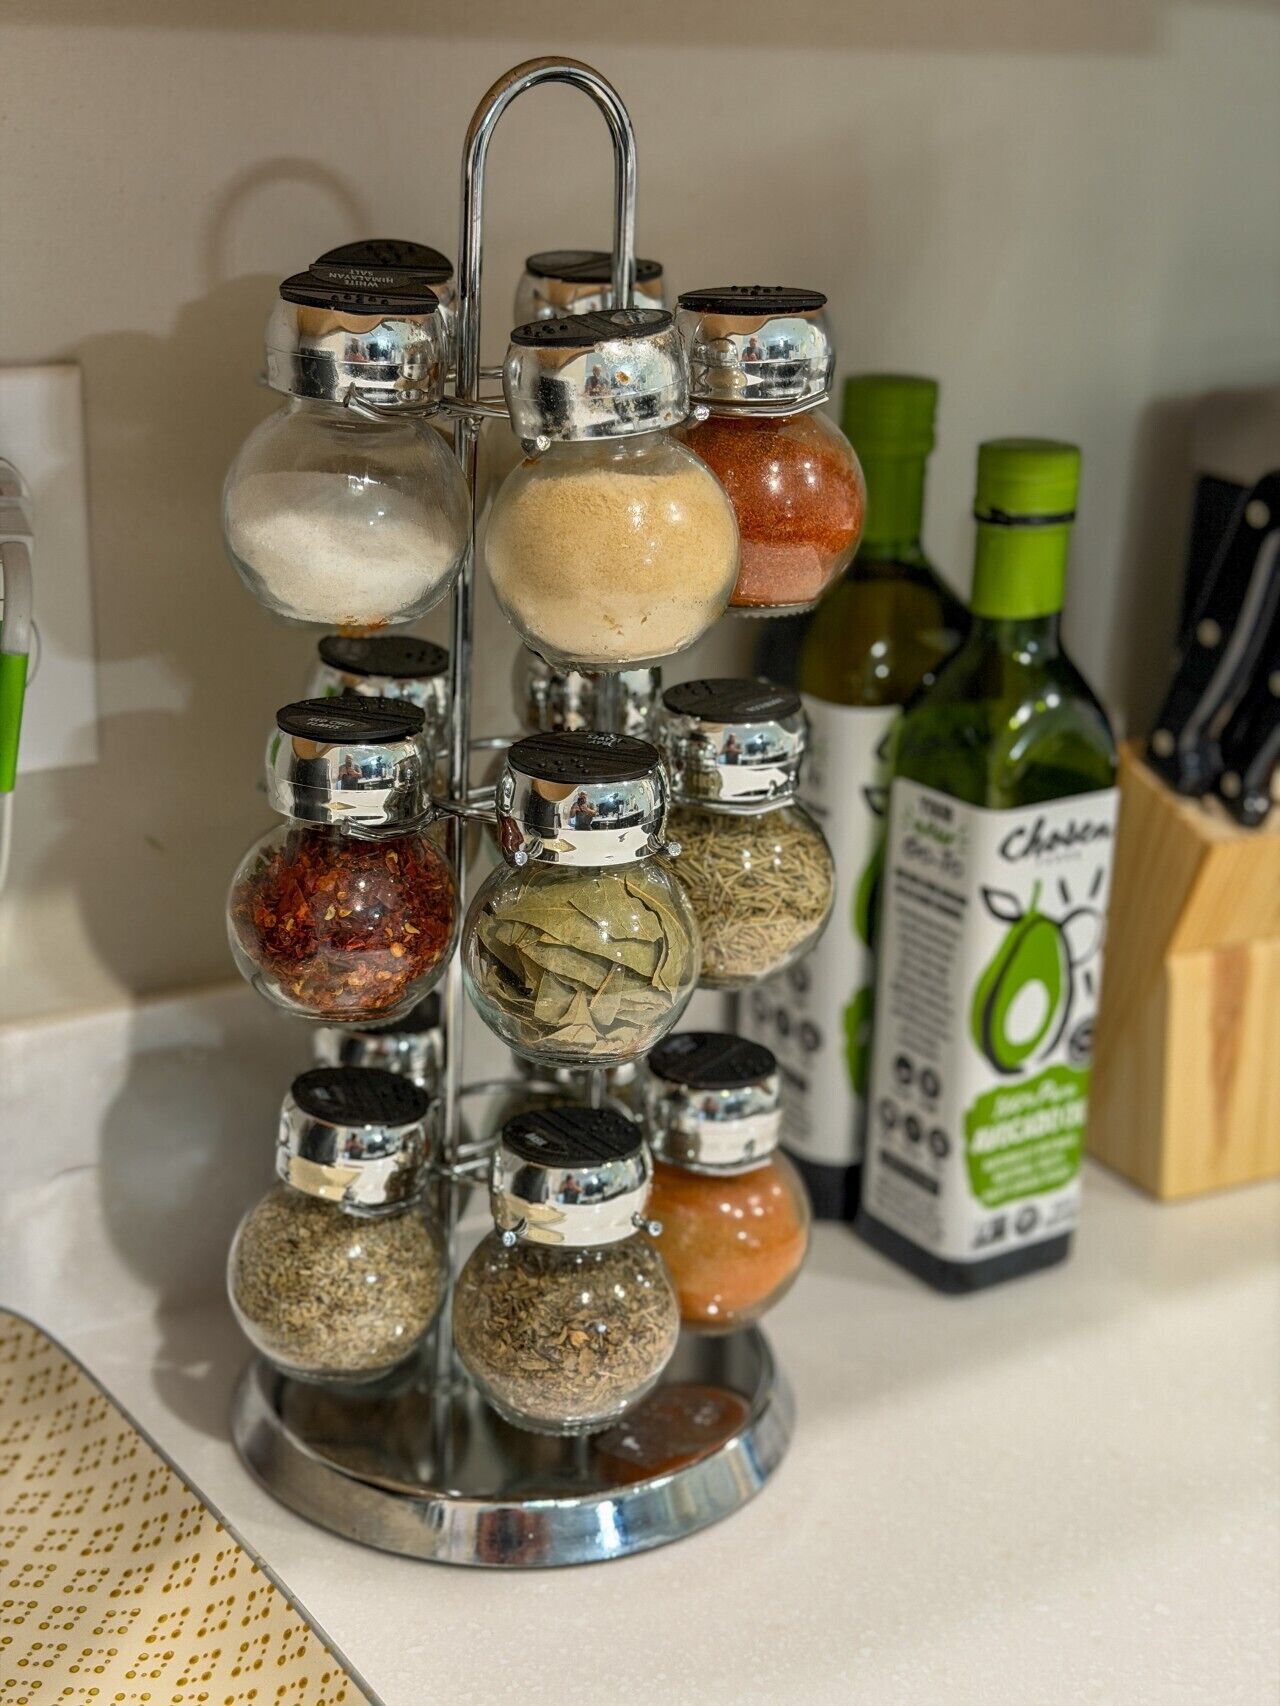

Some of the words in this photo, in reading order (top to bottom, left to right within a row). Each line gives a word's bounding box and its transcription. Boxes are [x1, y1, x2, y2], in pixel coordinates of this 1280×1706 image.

[328, 272, 394, 284] HIMALAYAN
[345, 279, 379, 288] WHITE
[999, 815, 1110, 862] Chosen
